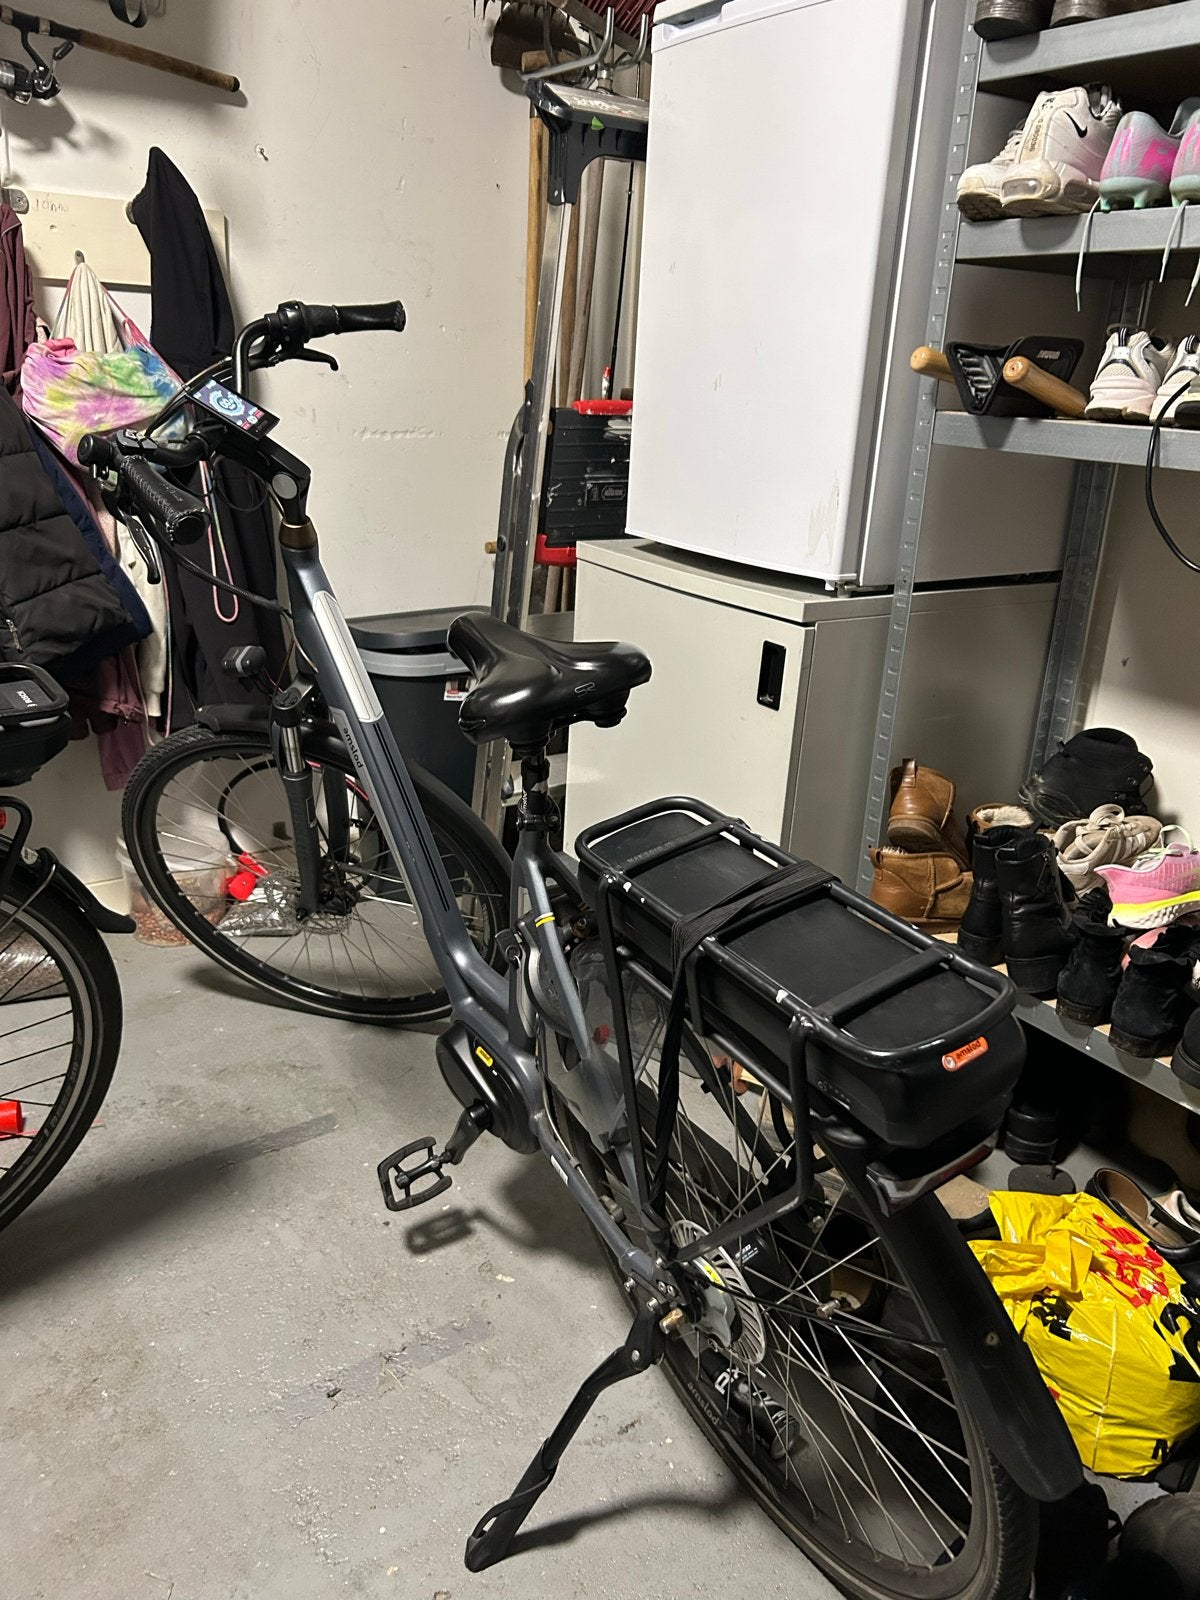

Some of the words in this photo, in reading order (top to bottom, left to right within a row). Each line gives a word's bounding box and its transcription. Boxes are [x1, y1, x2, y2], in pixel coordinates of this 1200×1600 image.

[343, 727, 365, 769] amslod
[955, 1038, 983, 1060] amslod
[687, 1381, 721, 1426] amslod
